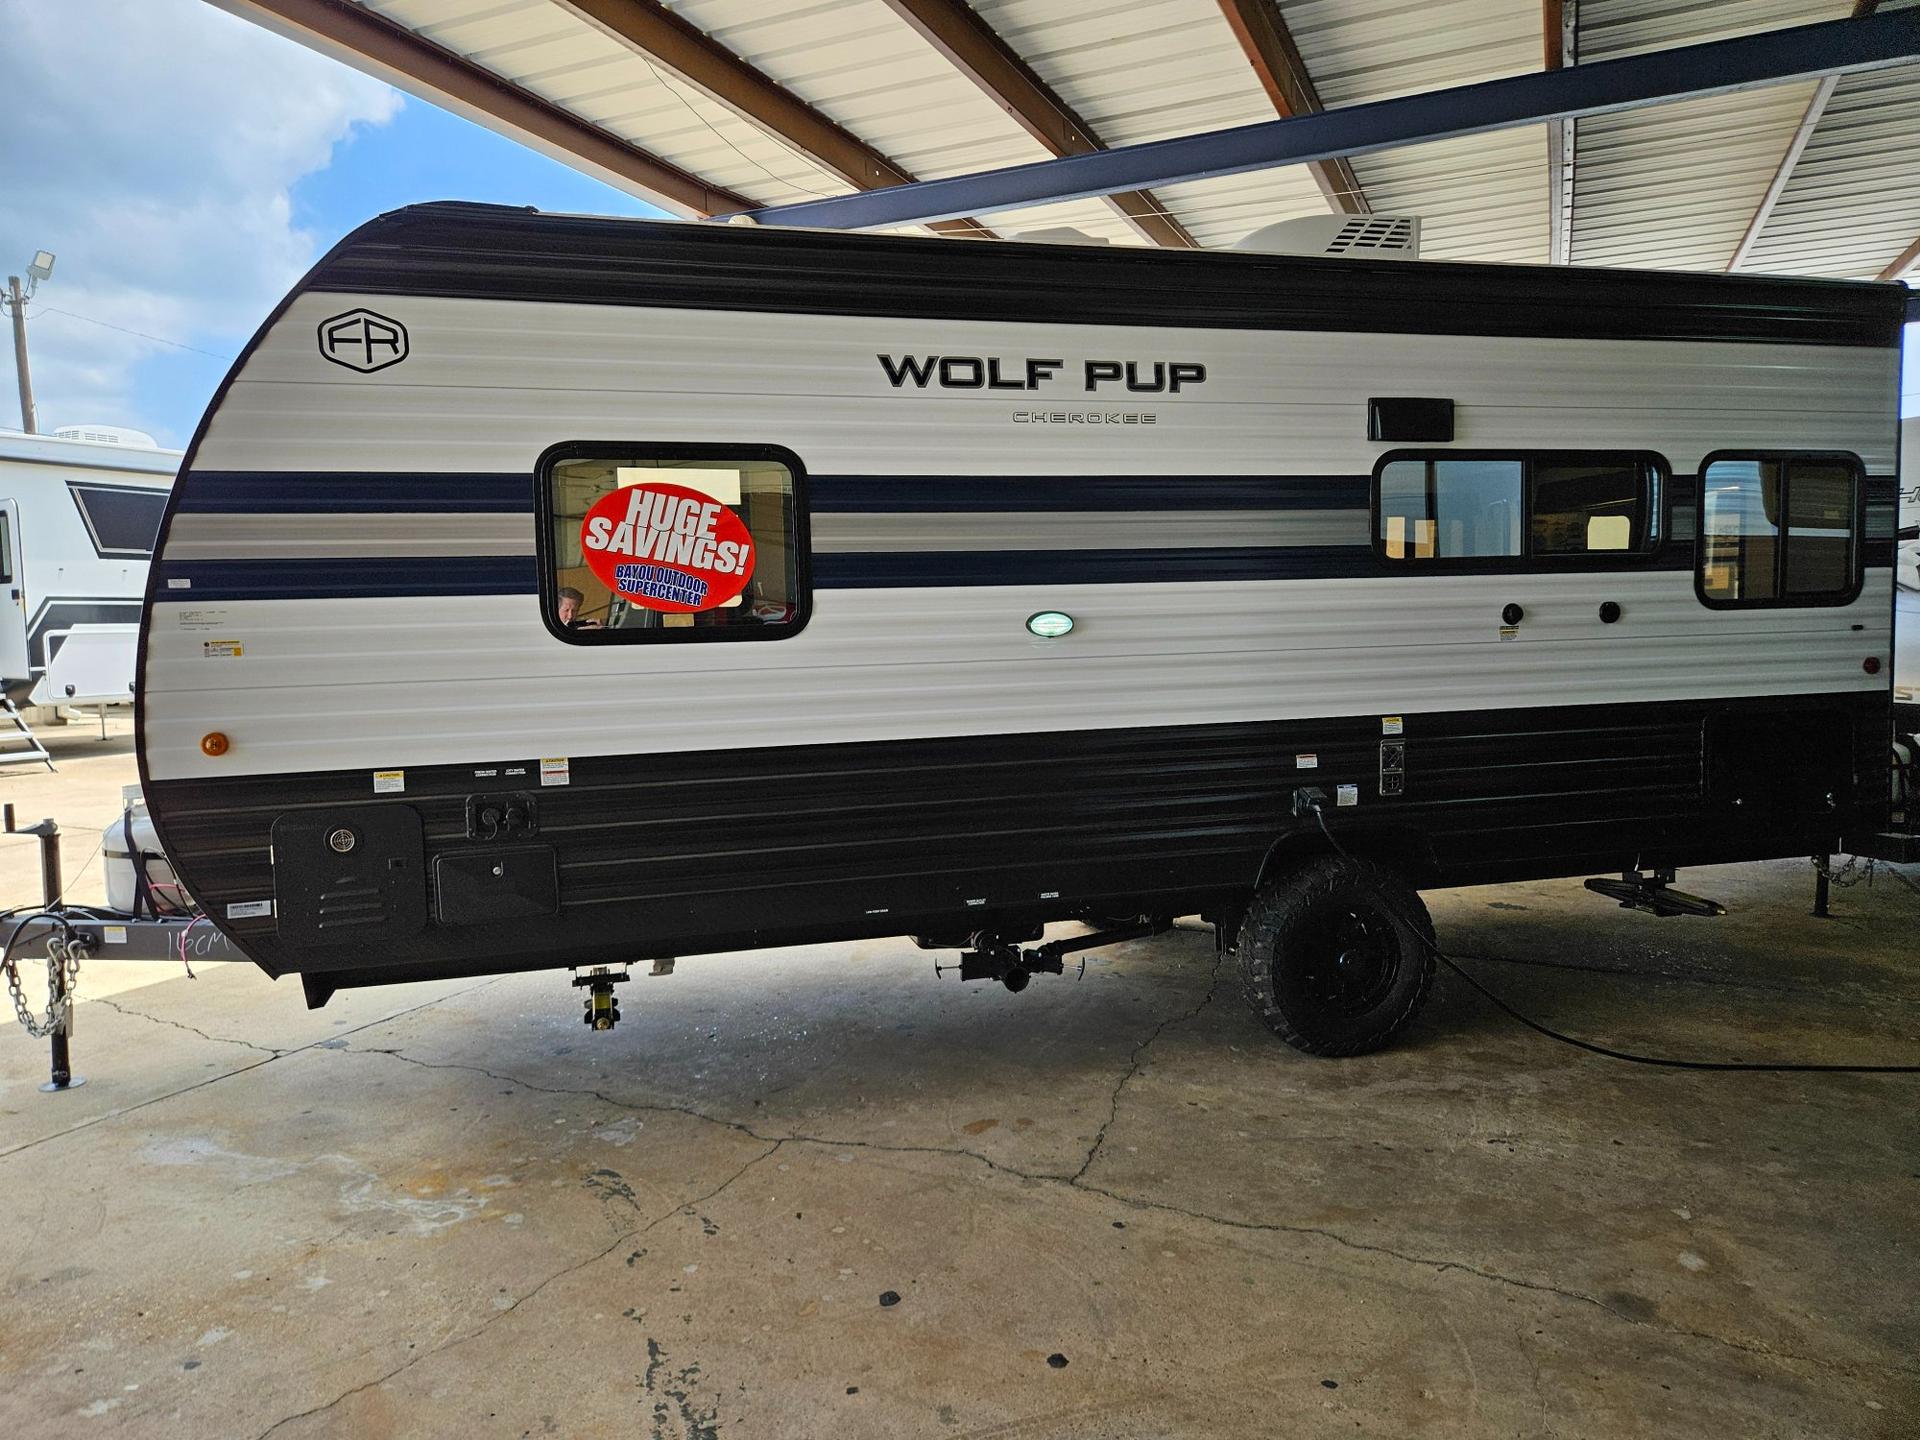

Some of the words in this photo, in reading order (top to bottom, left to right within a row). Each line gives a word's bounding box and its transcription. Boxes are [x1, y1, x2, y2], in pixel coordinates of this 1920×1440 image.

[877, 354, 1064, 390] WOLF
[1084, 359, 1207, 393] PUP
[1012, 411, 1157, 424] CHEROKEE
[625, 488, 721, 541] HUGE
[585, 516, 750, 576] SAVINGS!
[615, 564, 654, 581] BAYOU
[656, 566, 708, 596] OUTDOOR
[618, 579, 703, 607] SUPERCENTER
